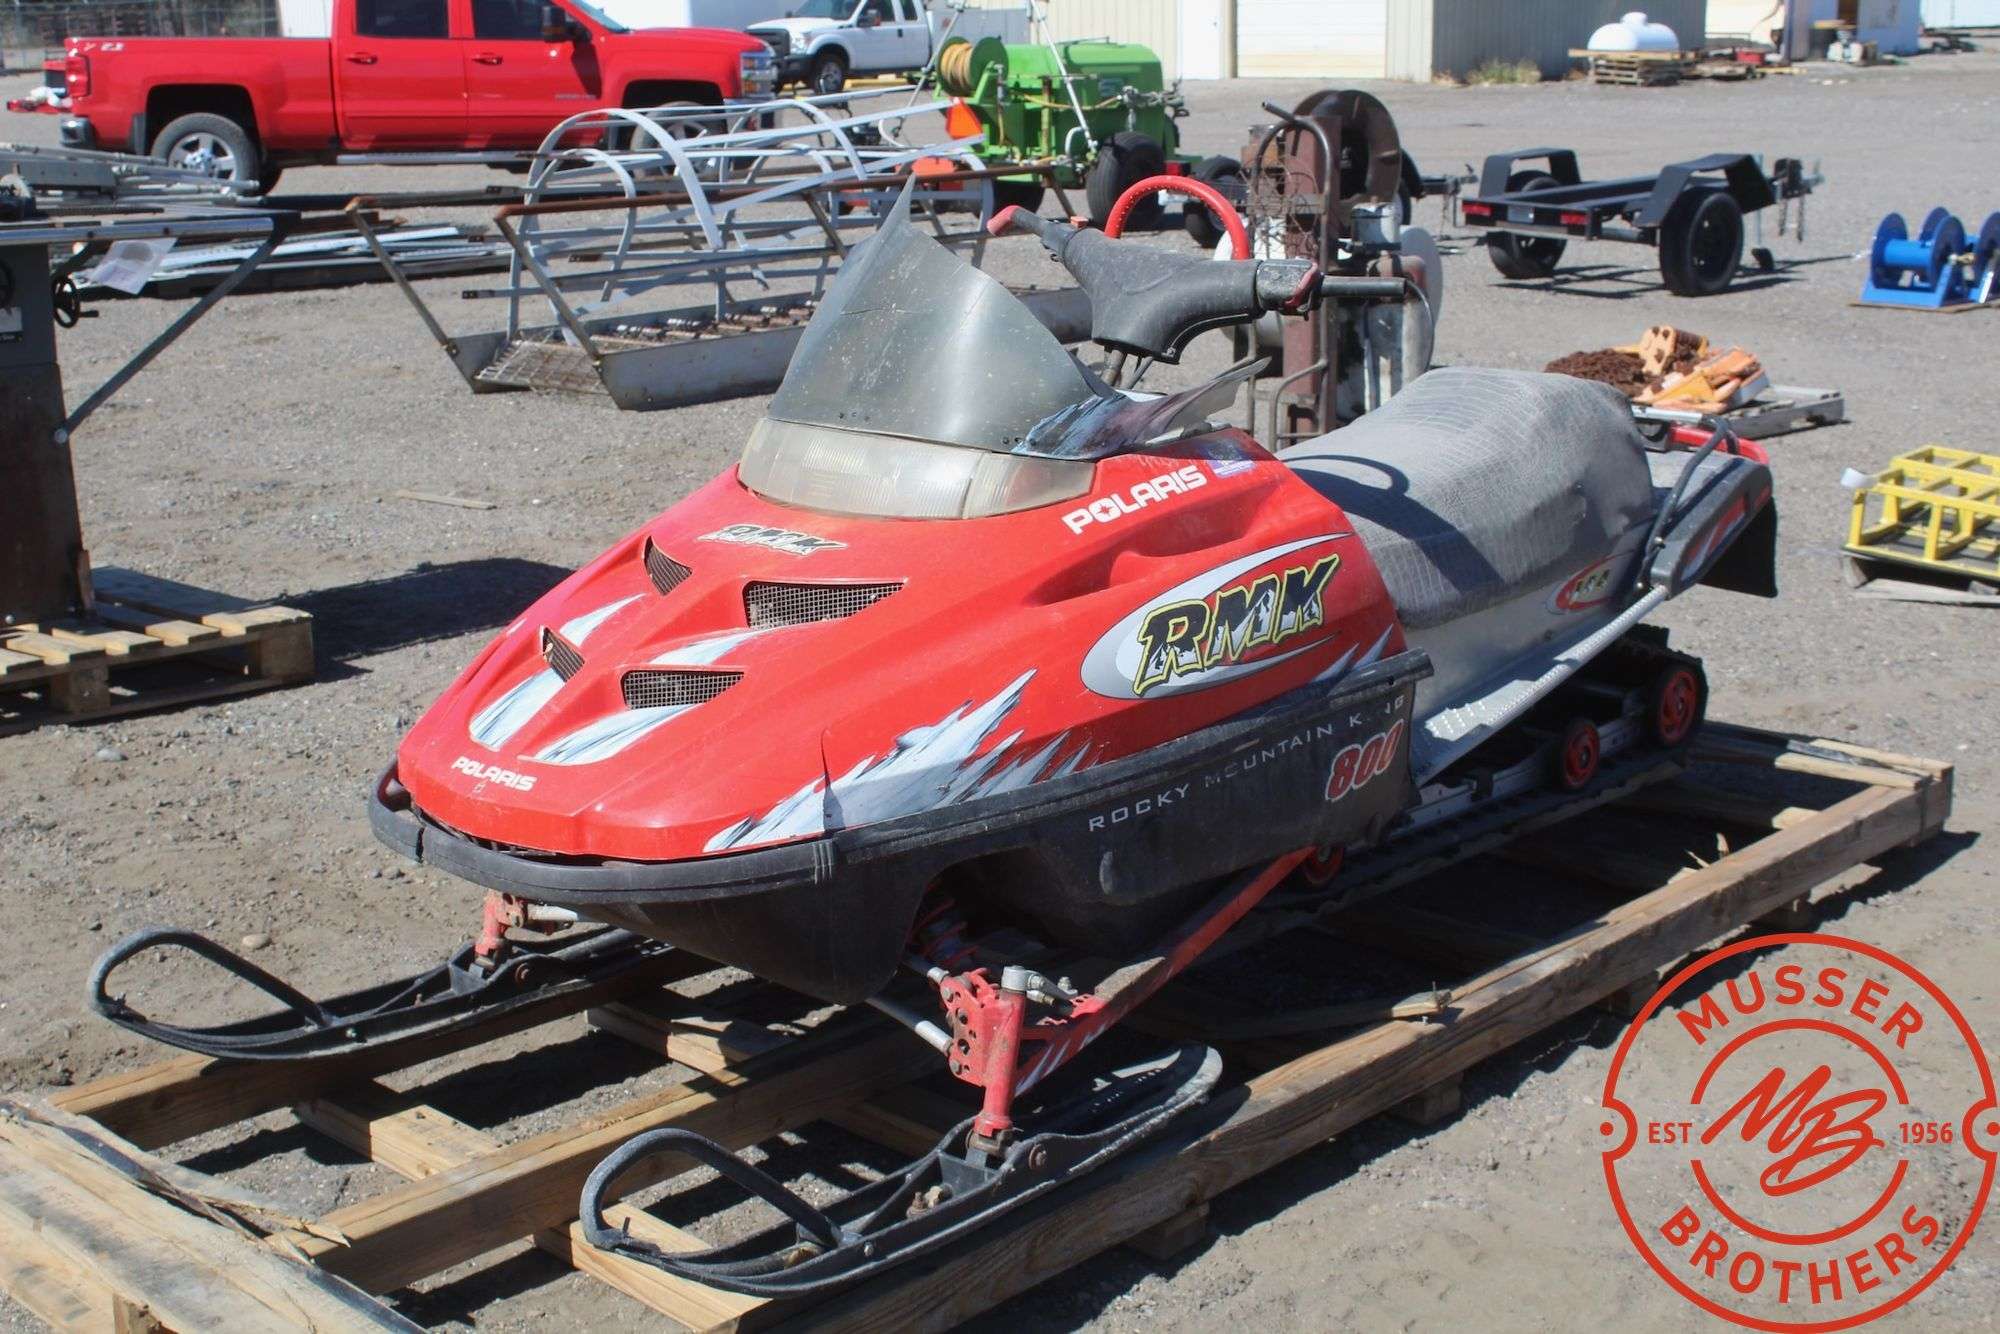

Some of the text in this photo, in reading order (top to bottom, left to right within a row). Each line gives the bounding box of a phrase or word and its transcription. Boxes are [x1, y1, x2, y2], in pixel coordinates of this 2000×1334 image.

[1061, 464, 1208, 535] POLARIS
[697, 523, 847, 556] RMK
[1132, 553, 1340, 697] RMK
[451, 756, 538, 792] POLARIS
[1089, 783, 1190, 832] ROCKY
[1349, 694, 1404, 728] KG
[1325, 718, 1404, 802] 800
